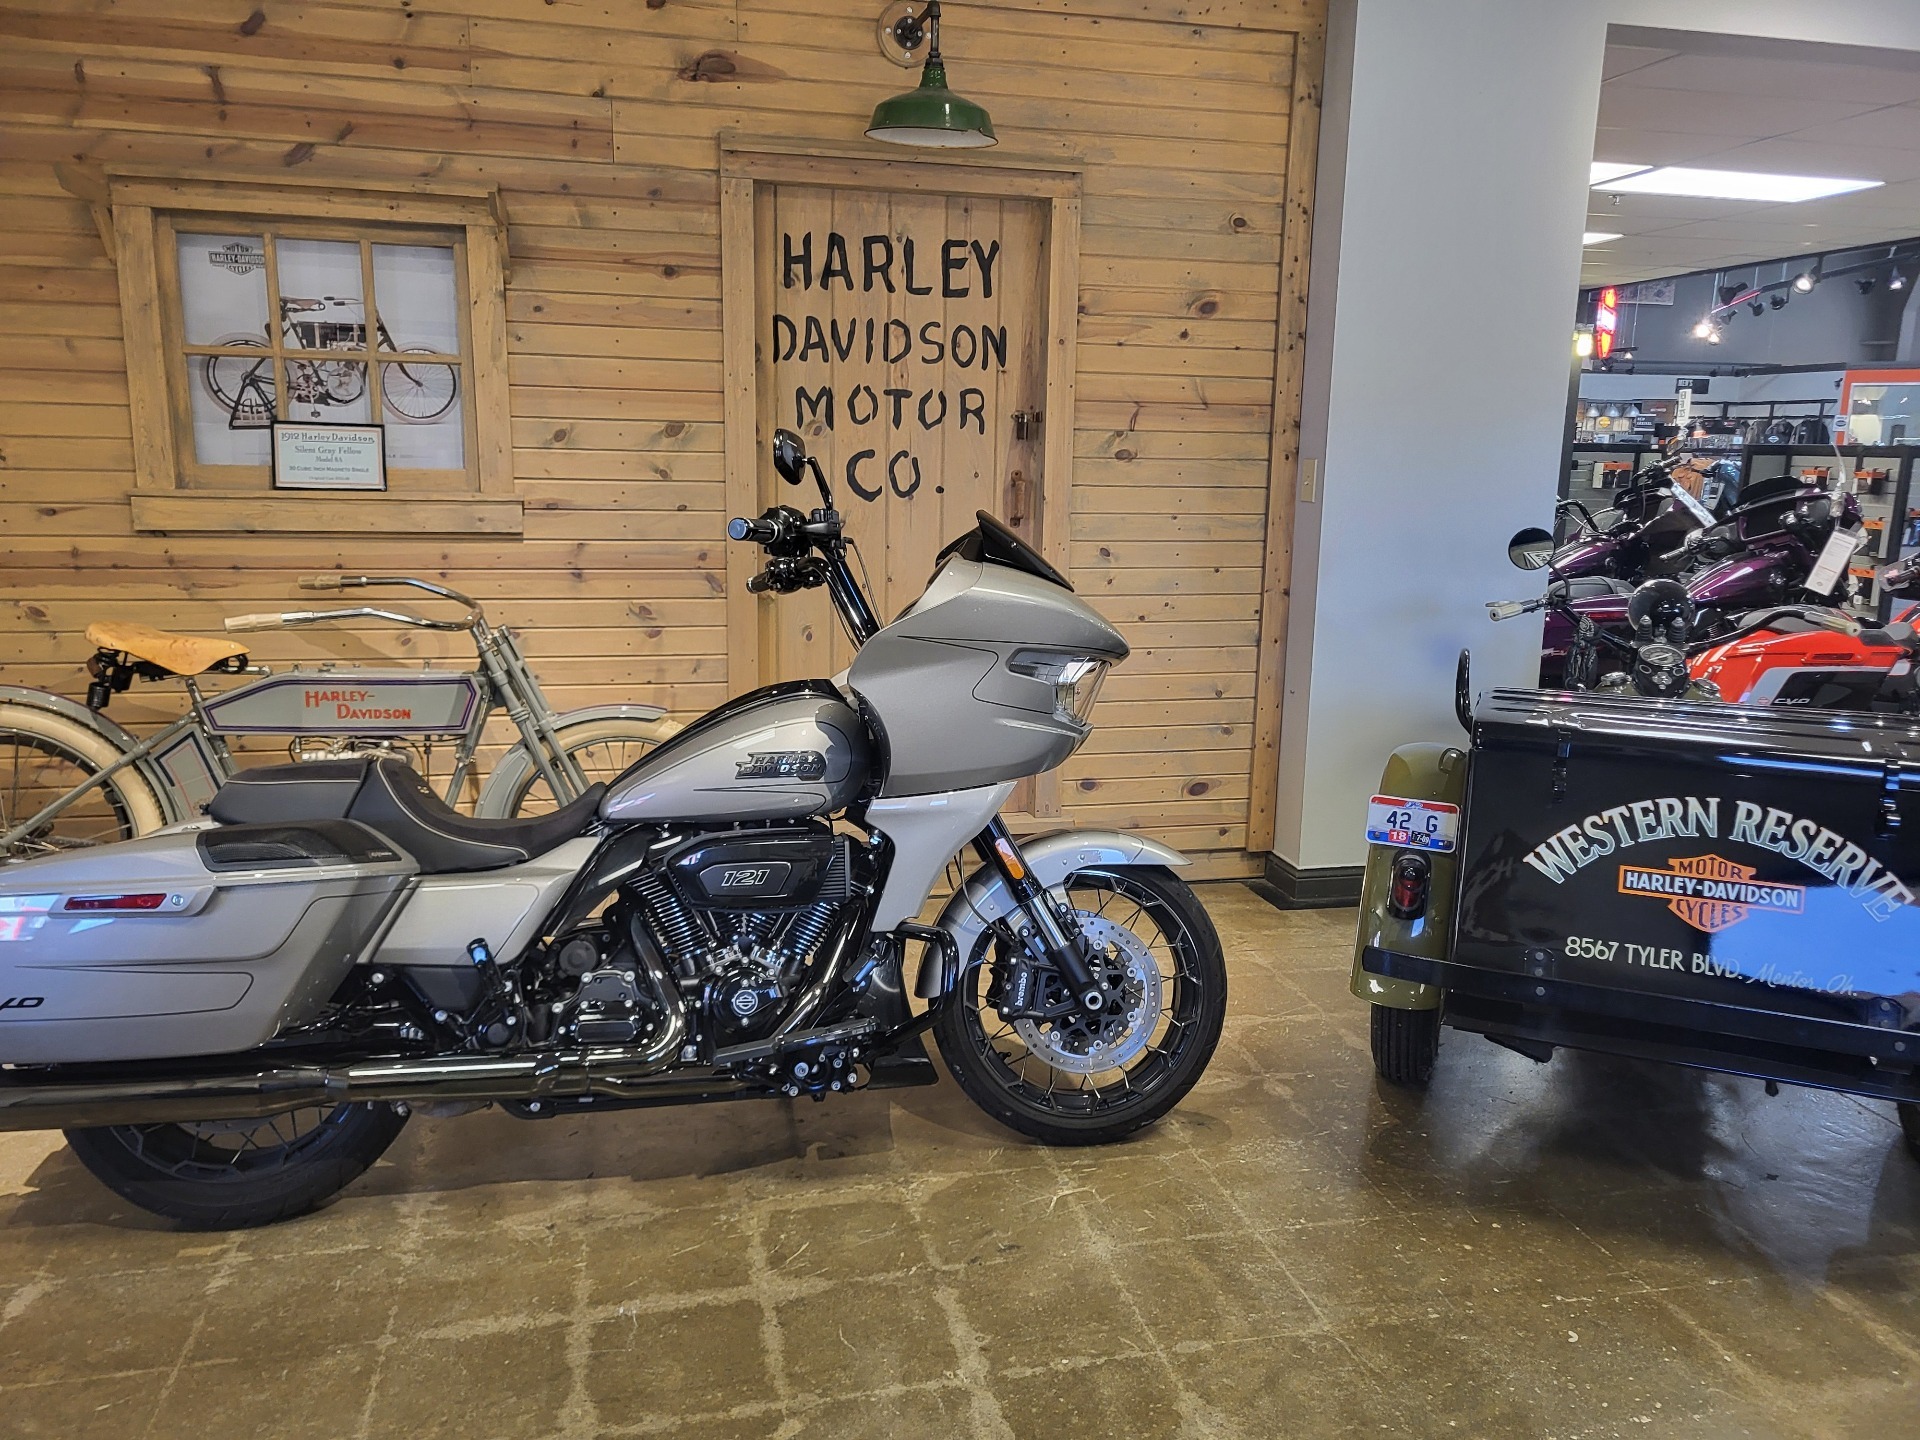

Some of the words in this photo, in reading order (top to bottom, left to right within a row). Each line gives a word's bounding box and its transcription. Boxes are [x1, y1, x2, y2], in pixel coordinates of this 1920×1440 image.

[783, 232, 1000, 298] HARLEY
[773, 314, 1007, 371] DAVIDSON
[795, 384, 985, 435] MOTOR
[281, 432, 300, 442] 1912
[318, 446, 336, 457] Gray
[338, 447, 362, 455] Fellow
[846, 449, 945, 502] CO.
[305, 690, 375, 708] HARLEY-
[336, 703, 411, 720] DAVIDSON
[740, 764, 821, 774] DAVIDSON
[1386, 810, 1412, 830] 42
[1425, 815, 1439, 834] G
[1391, 831, 1407, 841] 18
[1522, 796, 1721, 885] WESTERN
[1728, 799, 1916, 924] RESERVE
[1677, 856, 1743, 880] MOTOR
[721, 869, 770, 887] 121
[1625, 871, 1799, 908] HARLEY-DAVIDSON
[1676, 899, 1743, 930] CYCLES
[1564, 936, 1620, 962] 8567
[1624, 943, 1685, 972] TYLER
[1691, 952, 1743, 980] BLVD.
[1014, 971, 1028, 1007] brembo
